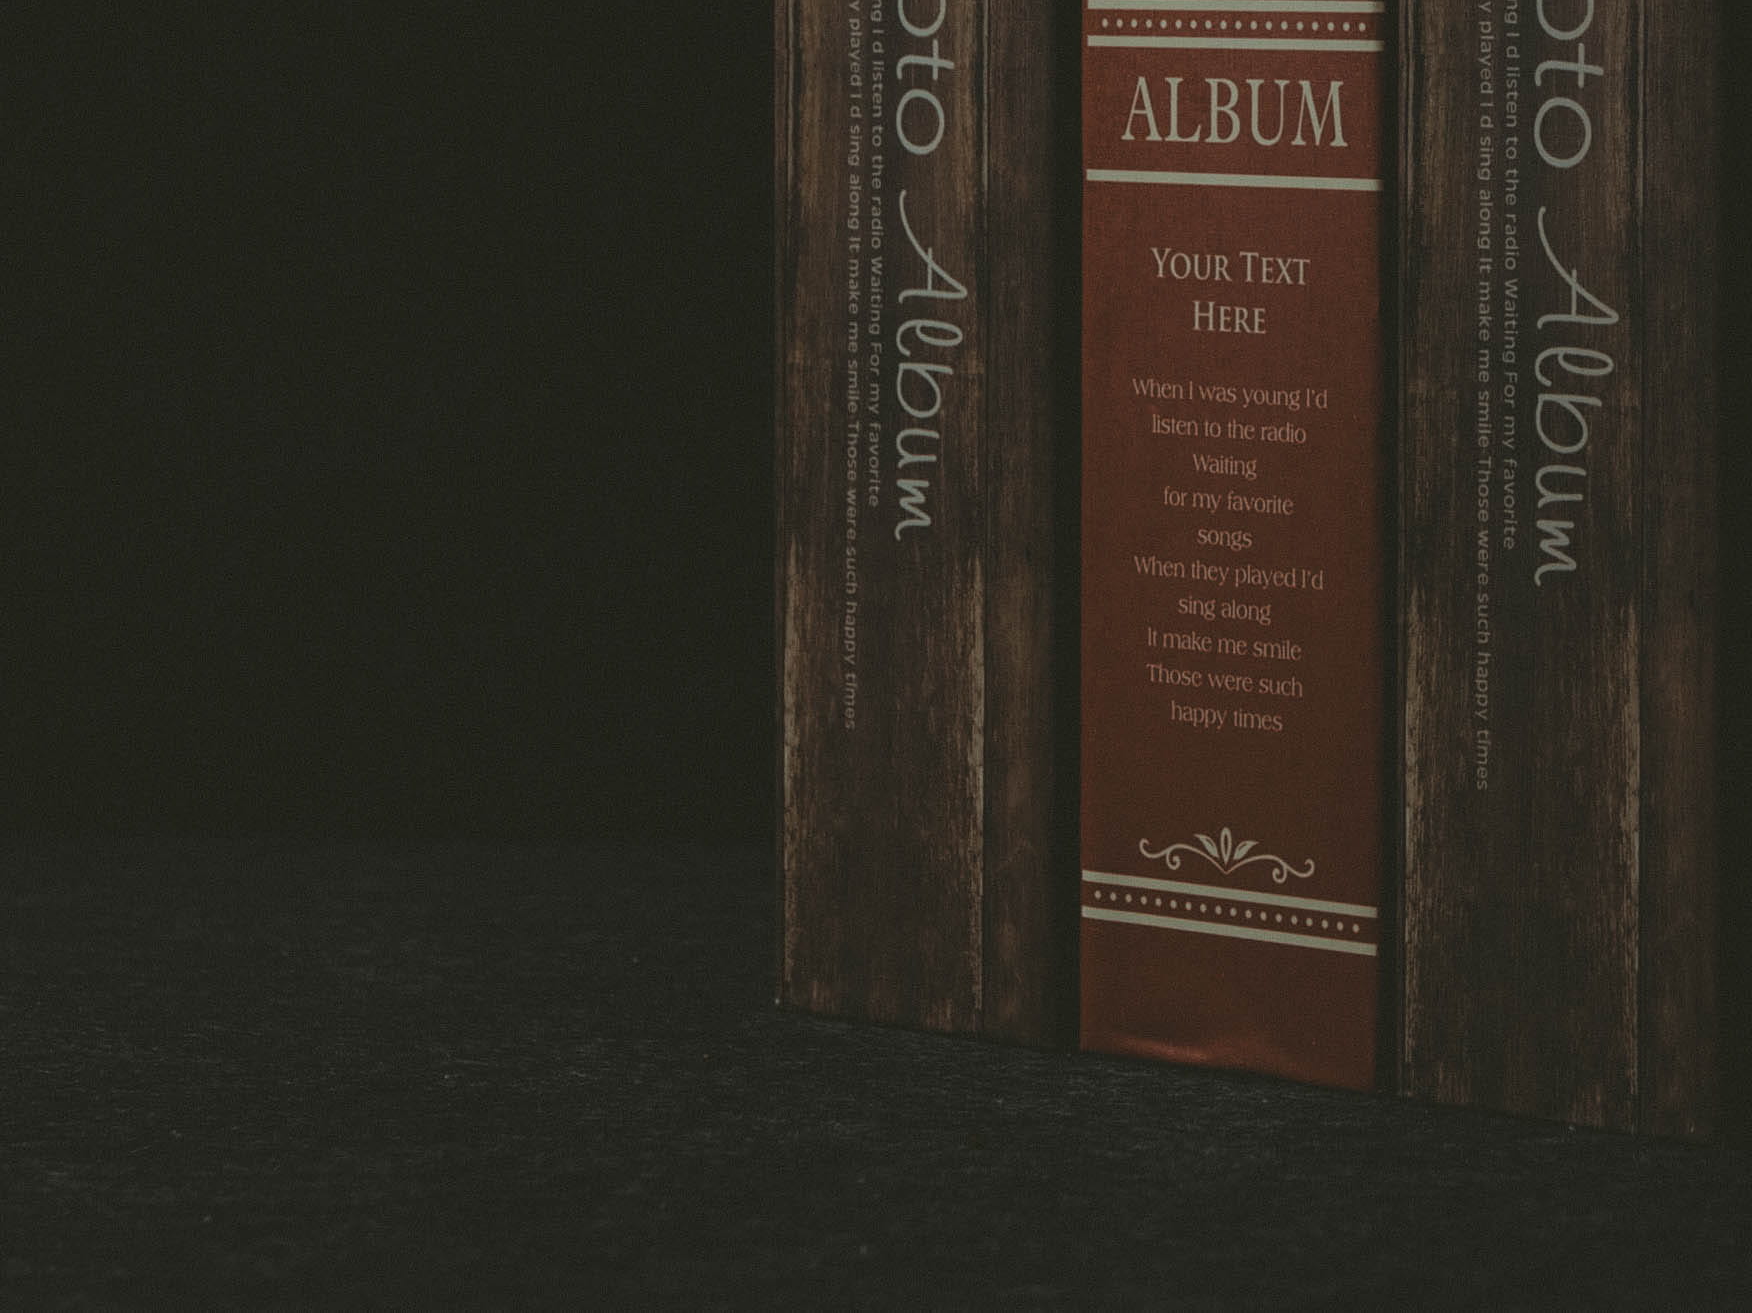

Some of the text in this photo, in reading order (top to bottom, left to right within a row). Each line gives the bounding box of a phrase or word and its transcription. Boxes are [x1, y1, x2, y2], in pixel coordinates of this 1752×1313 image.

[849, 17, 863, 86] played
[1478, 20, 1494, 95] played
[872, 60, 885, 118] listen
[1121, 76, 1348, 147] ALBUM
[1506, 67, 1521, 128] listen
[848, 125, 862, 166] sing
[872, 126, 884, 147] to
[1478, 136, 1494, 181] sing
[1506, 137, 1520, 160] to
[871, 155, 885, 190] the
[1506, 168, 1520, 207] the
[848, 174, 862, 230] along
[871, 197, 885, 249] radio
[1478, 189, 1493, 250] along
[1479, 257, 1493, 273] It
[1504, 213, 1520, 271] radio
[848, 259, 861, 314] make
[869, 257, 883, 335] Waiting
[1478, 278, 1492, 342] make
[848, 321, 858, 352] me
[1503, 279, 1519, 364] Waiting
[848, 360, 860, 411] smile
[895, 189, 968, 540] Album
[1478, 349, 1490, 383] me
[868, 378, 880, 414] my
[1132, 378, 1183, 399] When
[1199, 385, 1237, 403] was
[1242, 387, 1300, 411] young
[1306, 388, 1328, 409] I'd
[1478, 389, 1492, 447] smile
[1534, 206, 1619, 586] Album
[1152, 413, 1307, 444] listen to the radio
[1502, 416, 1515, 450] my
[868, 423, 881, 506] favorite
[1192, 453, 1257, 480] Waiting
[1478, 457, 1491, 523] Those
[846, 488, 857, 540] were
[1164, 486, 1294, 515] for my favorite
[1503, 458, 1518, 550] favorite
[1197, 528, 1253, 552] songs
[1477, 529, 1489, 585] were
[846, 546, 858, 595] such
[1134, 555, 1324, 590] When they played I'd
[844, 601, 858, 665] happy
[1178, 595, 1271, 626] sing along
[1477, 593, 1491, 644] such
[1147, 627, 1301, 661] It make me smile
[844, 673, 858, 730] times
[1146, 663, 1303, 698] Those were such
[1474, 652, 1491, 720] happy
[1171, 700, 1284, 732] happy times
[1477, 729, 1491, 790] times
